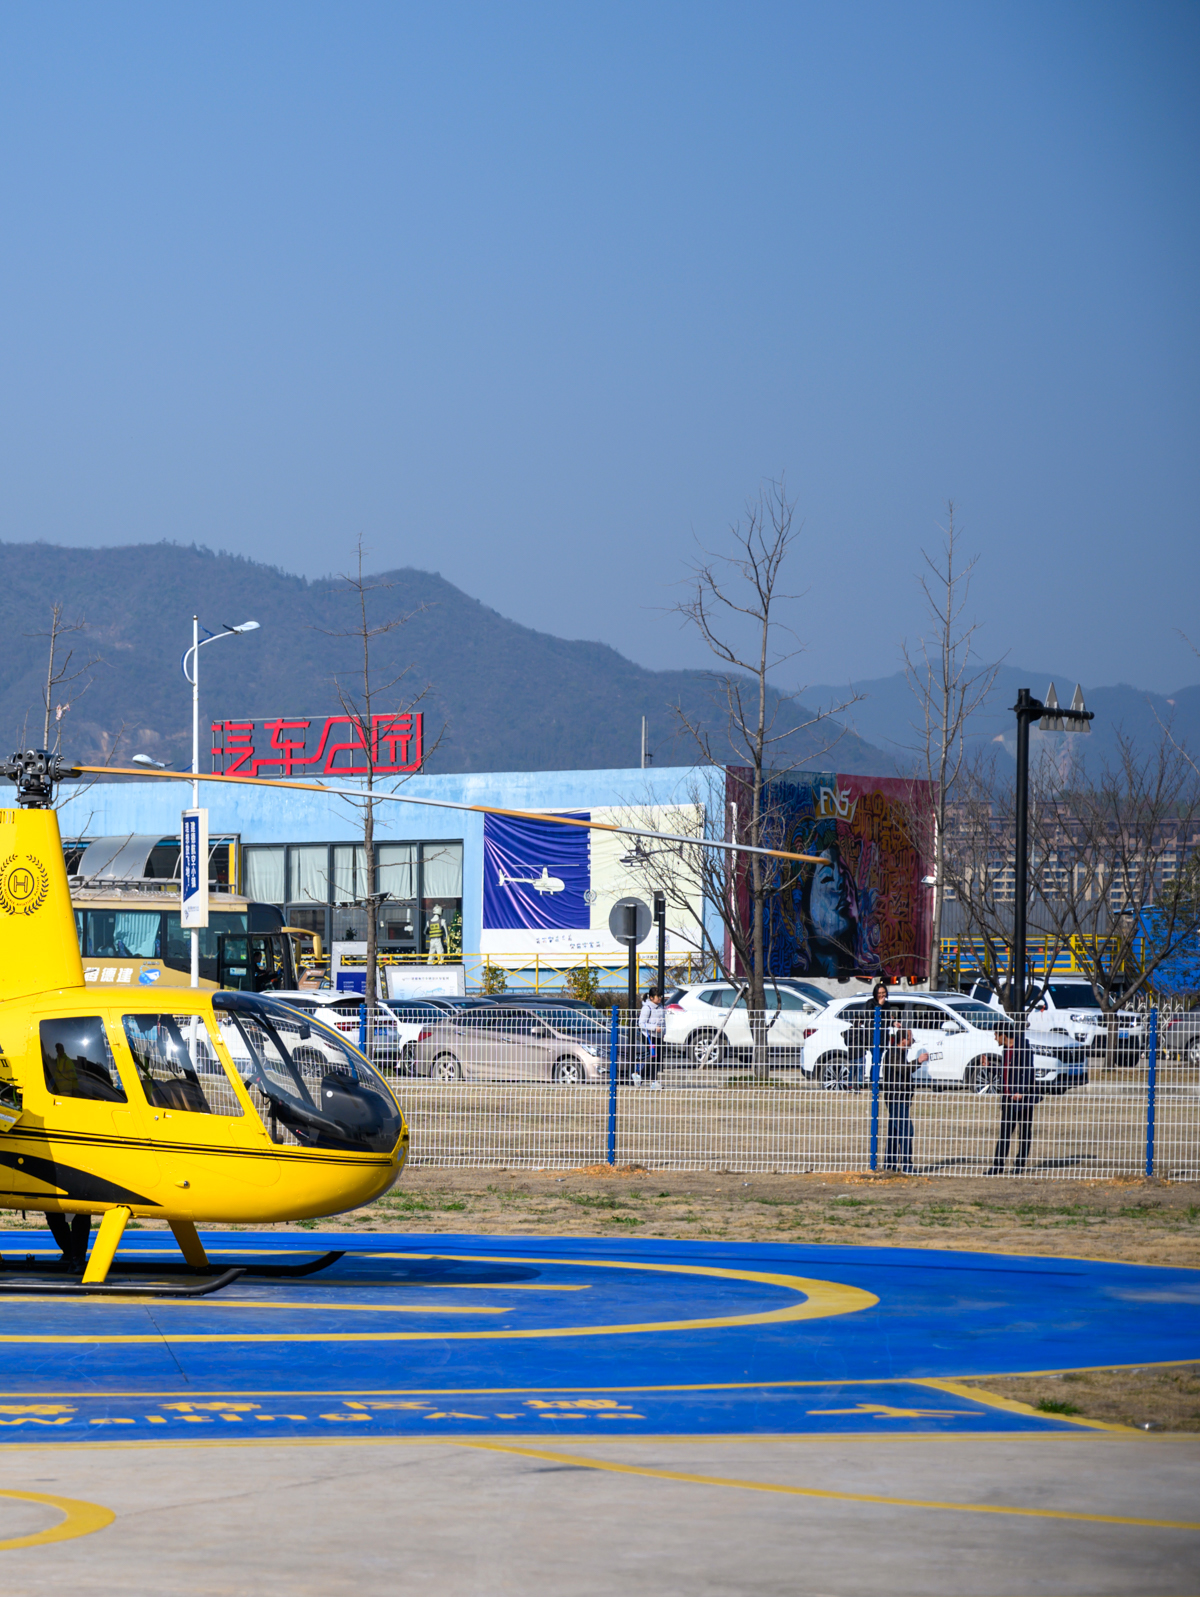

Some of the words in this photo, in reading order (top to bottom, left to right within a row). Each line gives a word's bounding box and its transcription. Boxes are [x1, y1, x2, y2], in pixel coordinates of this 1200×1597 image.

[211, 713, 424, 776] 汽车公园
[13, 875, 28, 893] H
[423, 1411, 647, 1420] Area
